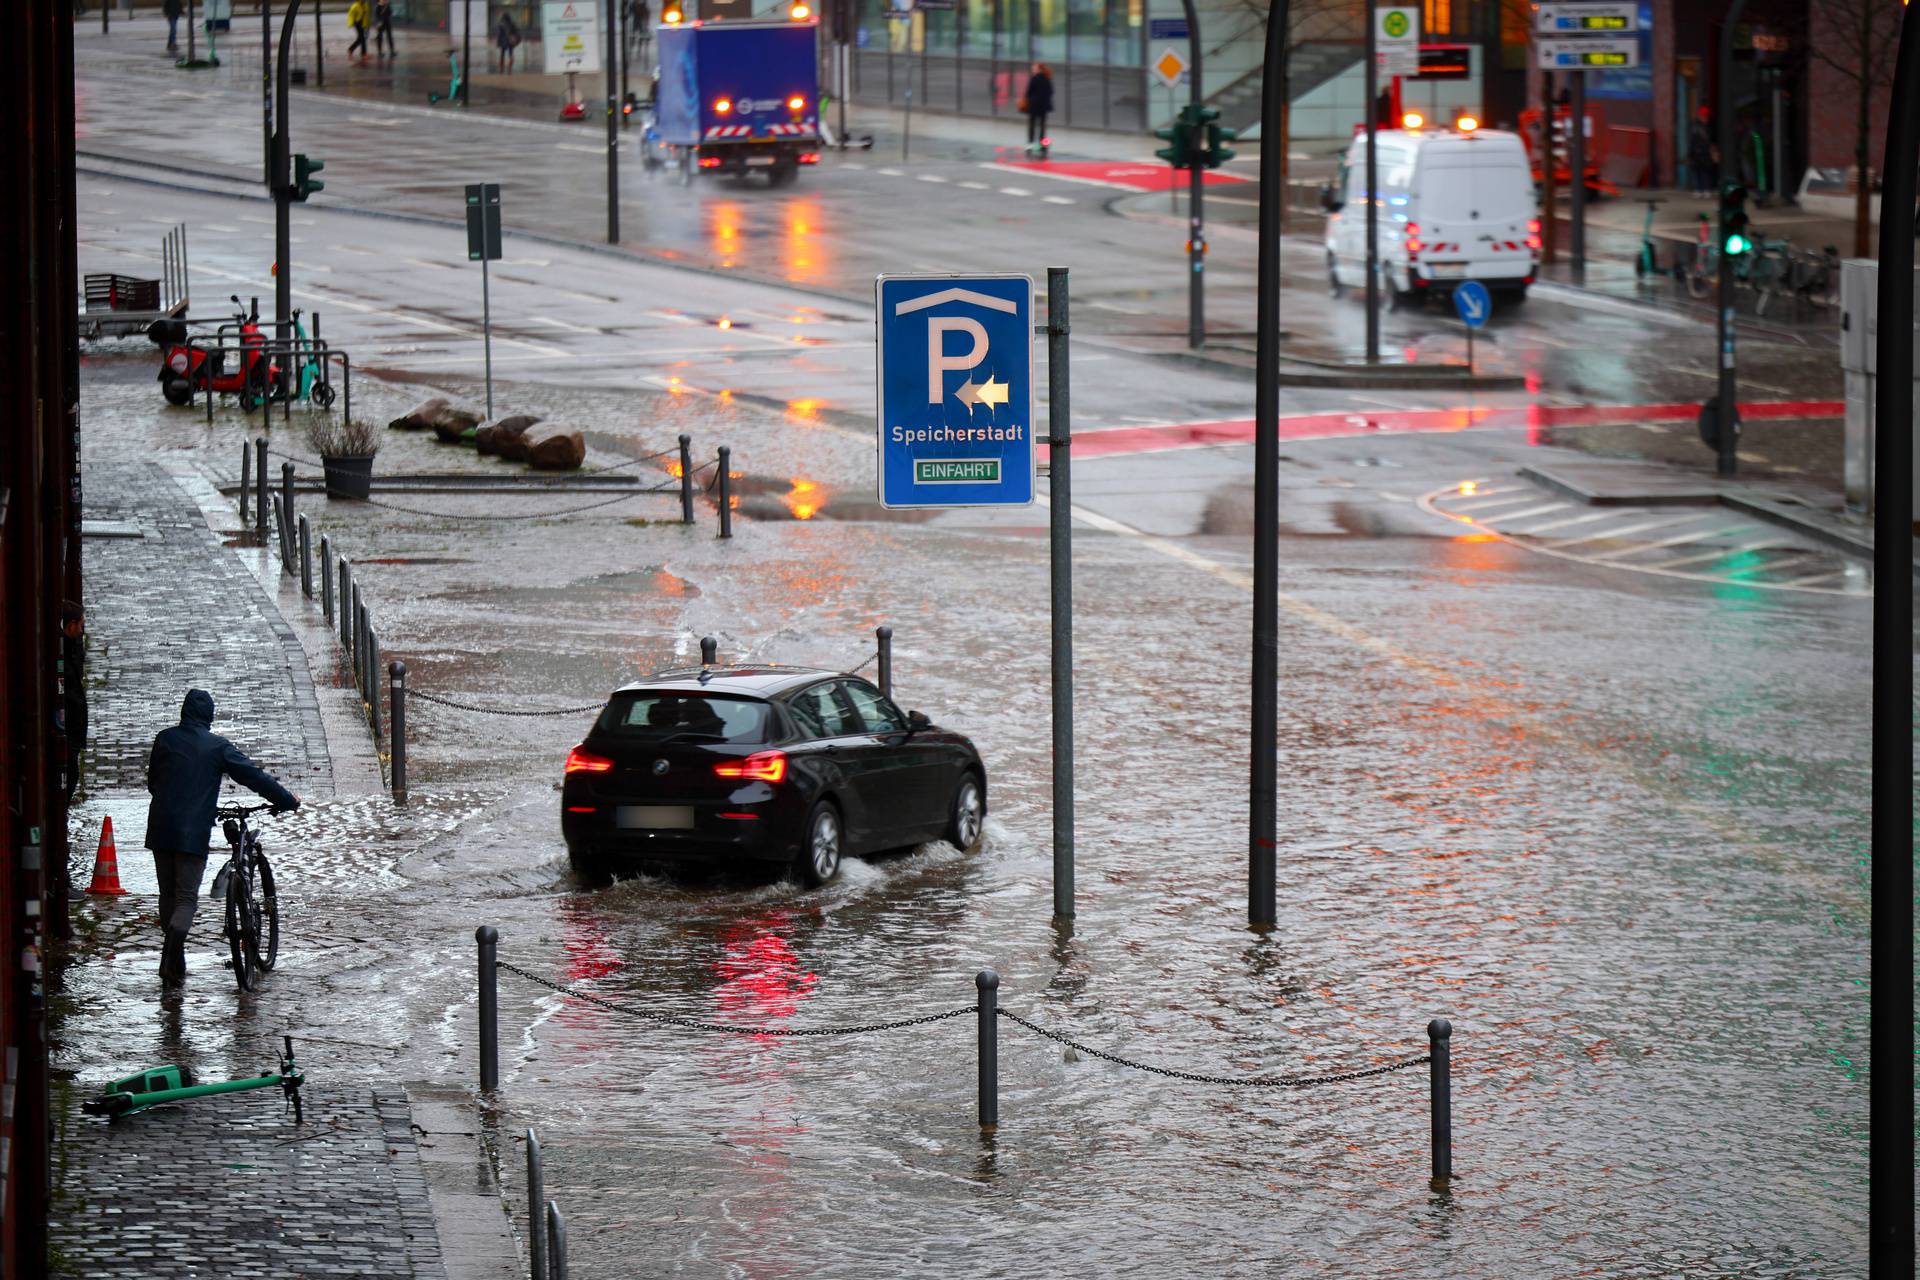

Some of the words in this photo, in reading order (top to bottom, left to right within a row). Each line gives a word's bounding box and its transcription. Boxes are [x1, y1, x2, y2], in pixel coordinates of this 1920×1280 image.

[928, 316, 990, 404] P
[892, 425, 1023, 445] Speicherstadt
[922, 463, 994, 479] EINFAHRT
